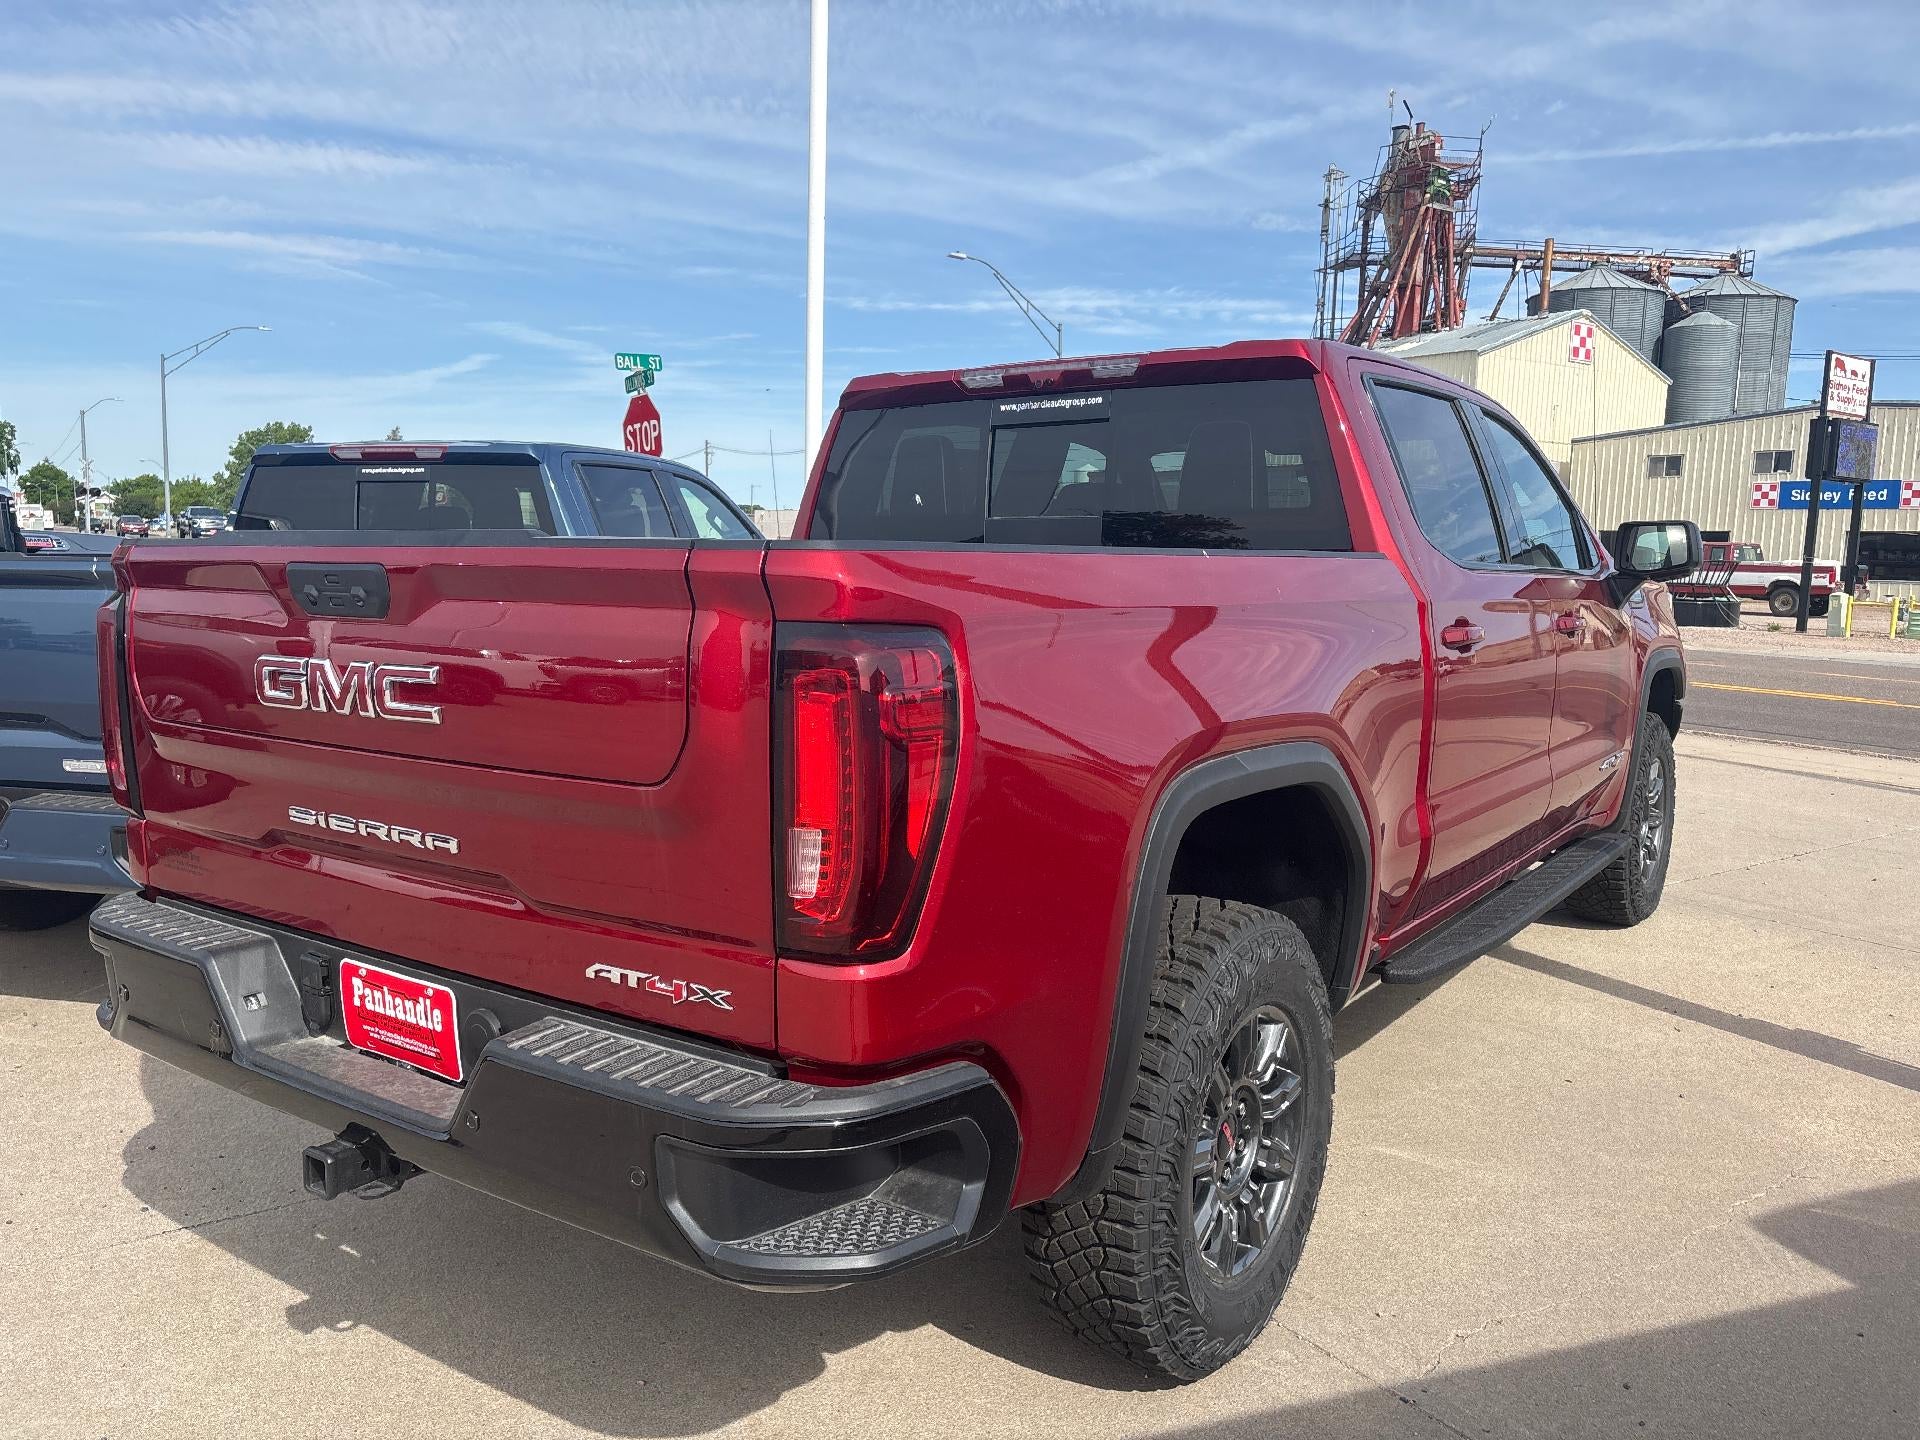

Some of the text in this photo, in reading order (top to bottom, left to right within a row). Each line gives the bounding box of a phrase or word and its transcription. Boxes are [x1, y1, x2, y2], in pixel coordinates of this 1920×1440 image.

[616, 355, 661, 369] BALL ST
[1829, 379, 1868, 396] Sidney Feed
[1829, 391, 1835, 401] &
[626, 420, 659, 453] STOP
[254, 654, 442, 725] GMC
[288, 805, 460, 855] SIERRA
[352, 976, 442, 1032] Panhandle
[585, 962, 735, 1012] AT4X
